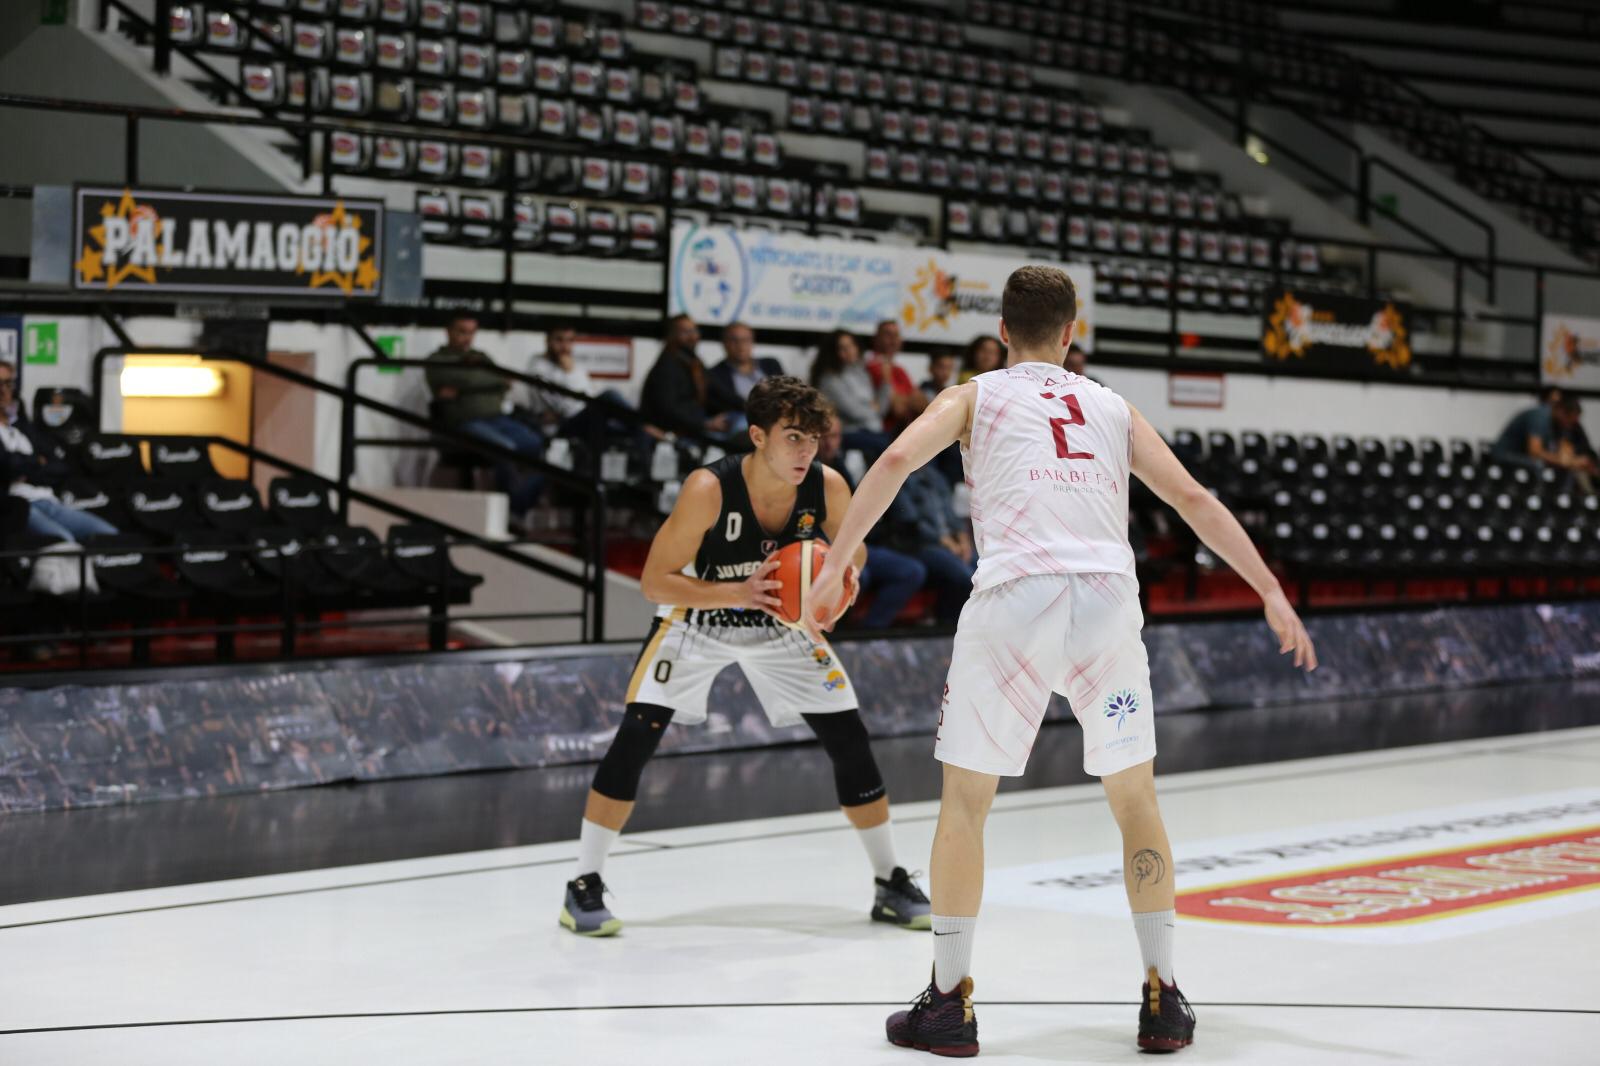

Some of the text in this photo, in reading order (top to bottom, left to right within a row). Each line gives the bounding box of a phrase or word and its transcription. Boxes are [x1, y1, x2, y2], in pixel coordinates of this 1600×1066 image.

[1039, 392, 1095, 460] 2
[725, 512, 743, 542] 0
[653, 659, 672, 683] 0
